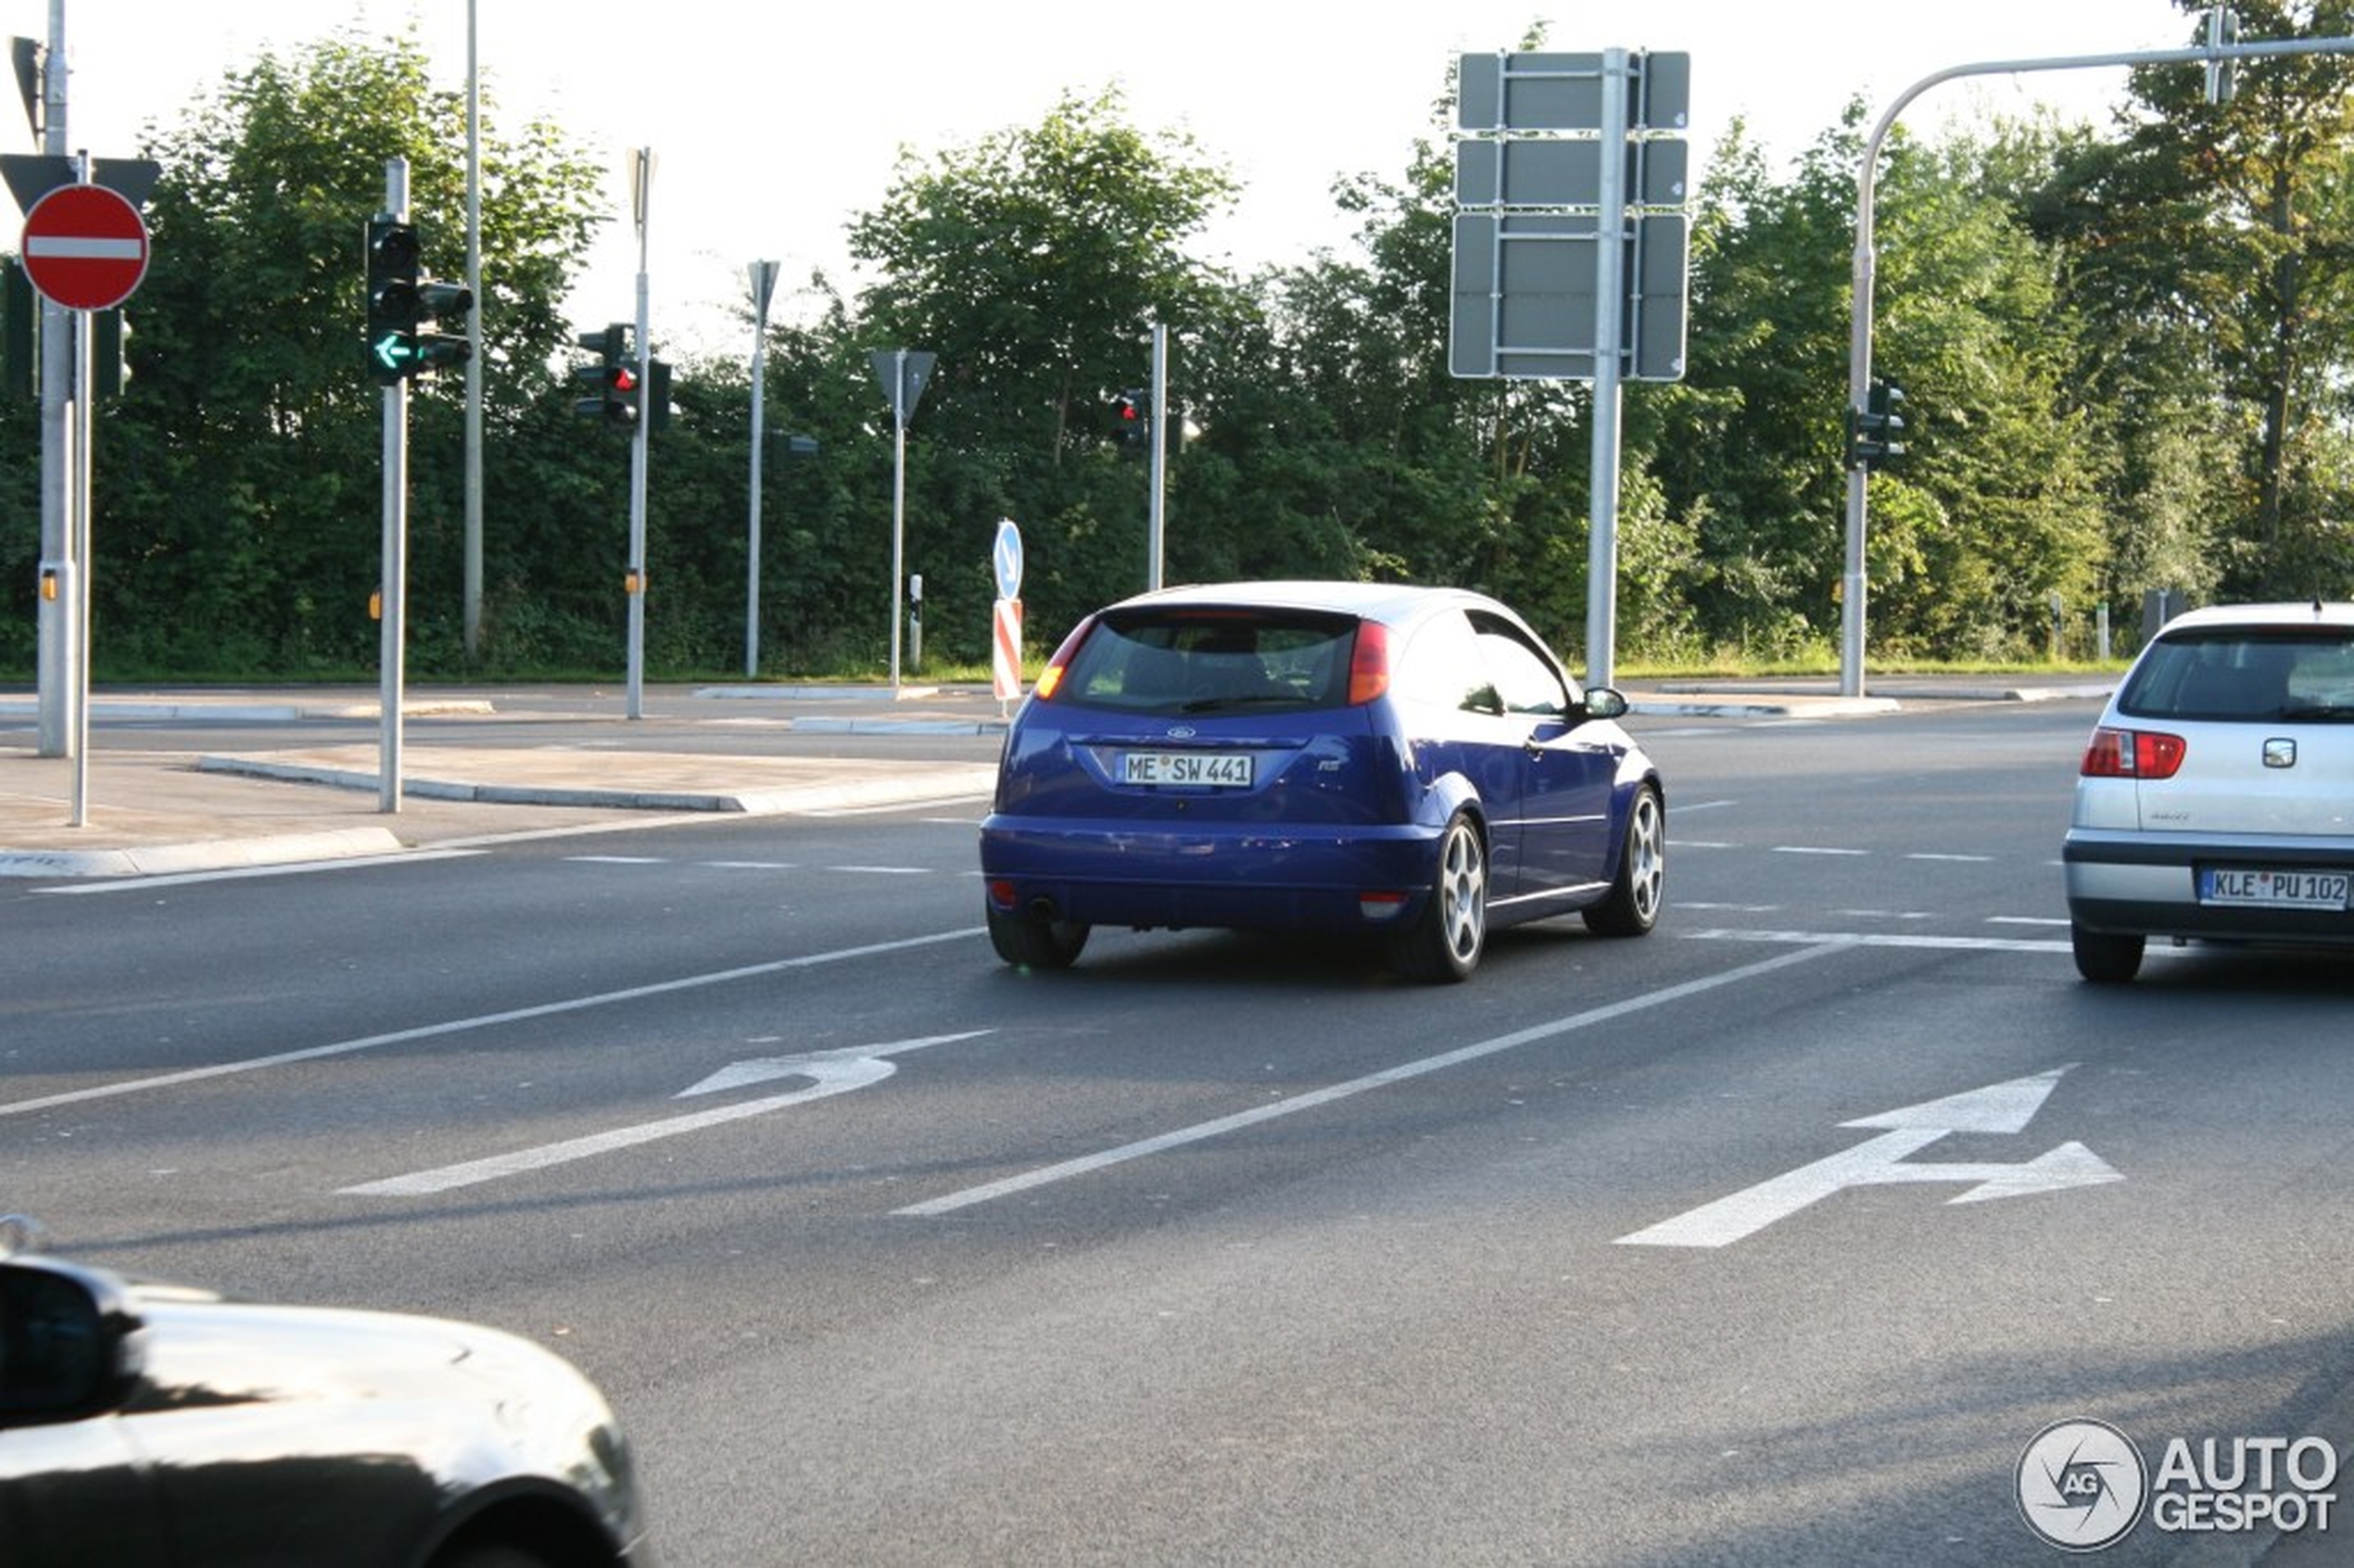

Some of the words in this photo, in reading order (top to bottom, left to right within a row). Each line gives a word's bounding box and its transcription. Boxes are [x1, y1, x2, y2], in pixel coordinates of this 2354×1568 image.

[1128, 757, 1157, 779] ME
[1172, 758, 1202, 781] SW
[1207, 759, 1247, 782] 441
[2215, 873, 2256, 897] KLE
[2272, 875, 2300, 899] PU
[2305, 877, 2346, 901] 102
